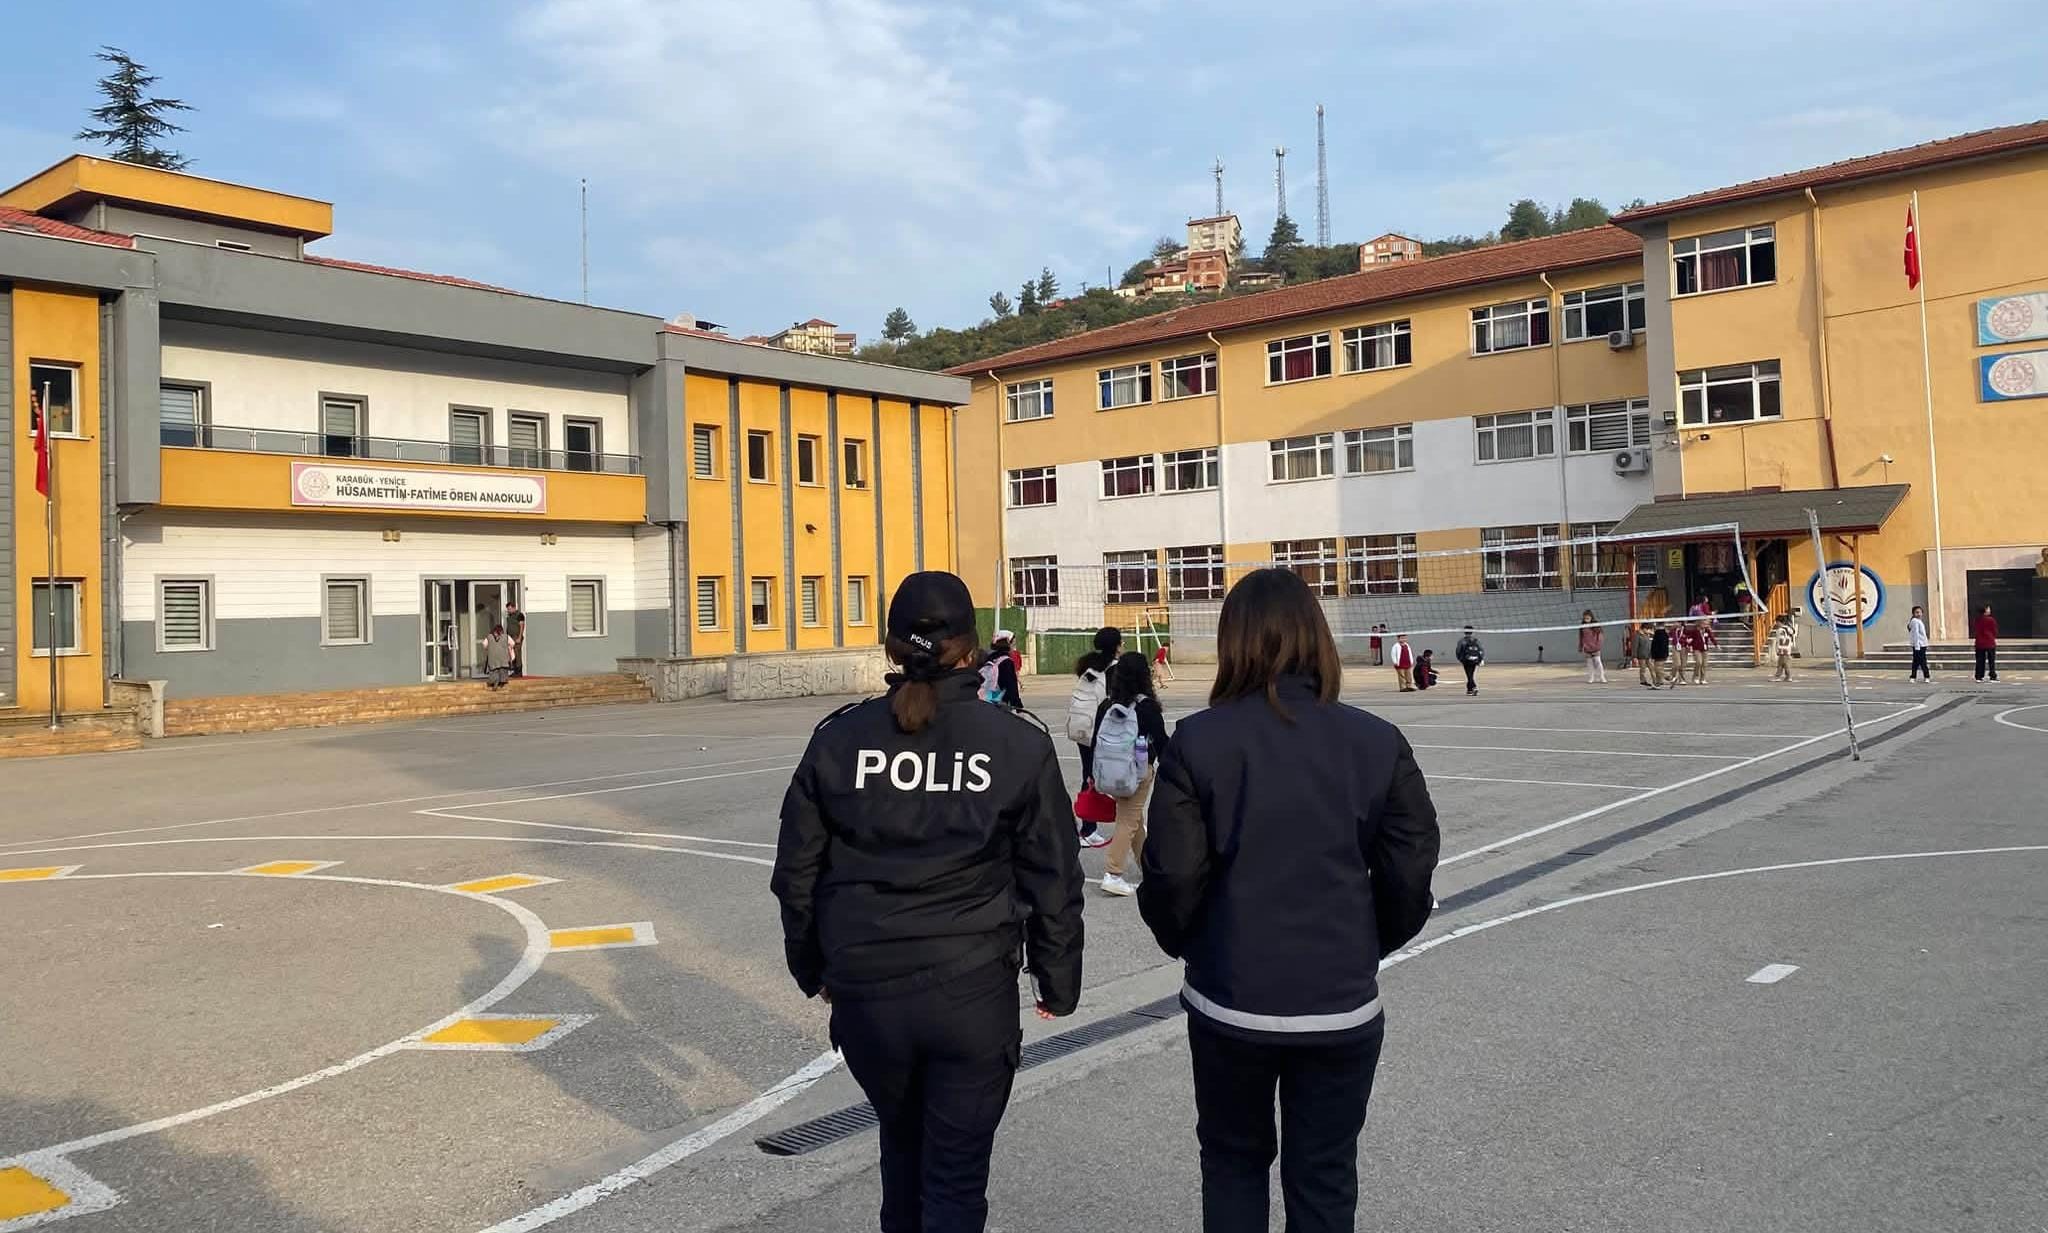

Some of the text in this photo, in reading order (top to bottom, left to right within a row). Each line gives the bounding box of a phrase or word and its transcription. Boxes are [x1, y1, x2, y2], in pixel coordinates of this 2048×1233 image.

[336, 474, 374, 484] KARABÜK
[449, 488, 478, 502] ÖREN
[480, 491, 533, 504] ANAOKULU
